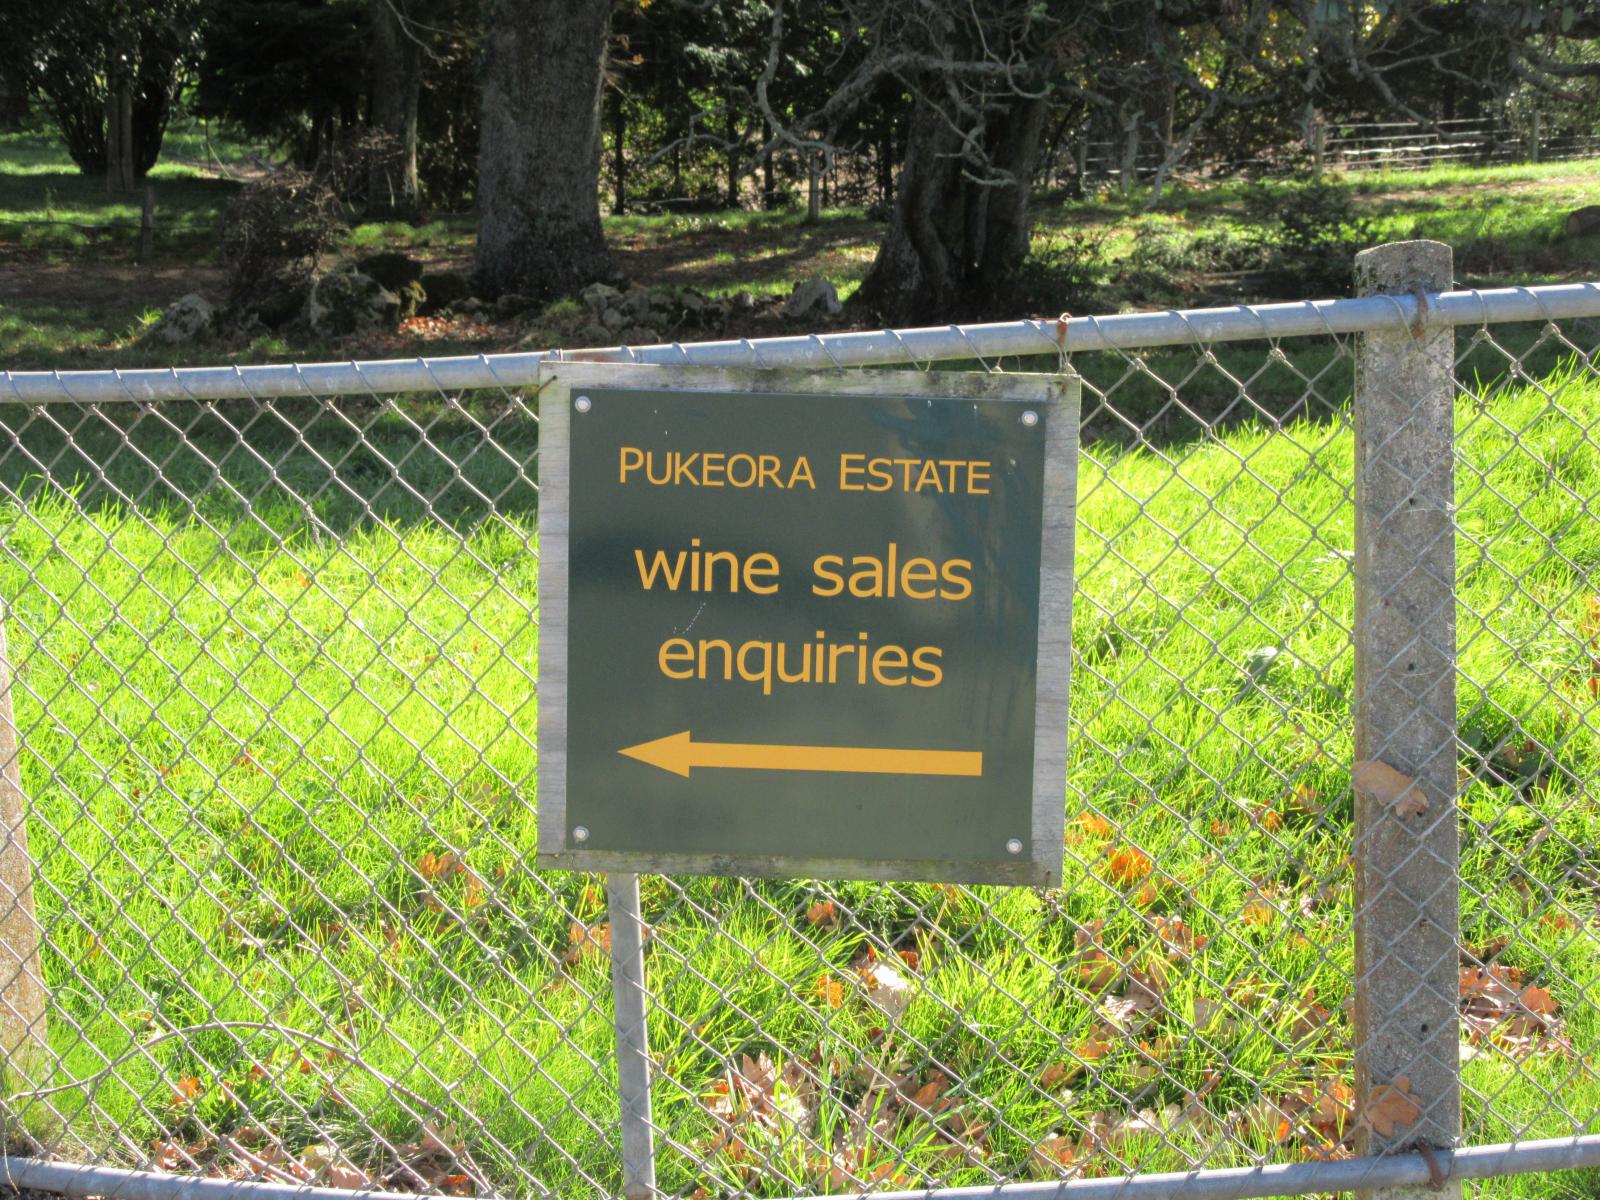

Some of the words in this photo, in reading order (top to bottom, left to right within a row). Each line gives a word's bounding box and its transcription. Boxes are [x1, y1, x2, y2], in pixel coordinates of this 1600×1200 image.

[618, 446, 817, 490] PUKEORA
[838, 452, 993, 496] ESTATE
[634, 537, 781, 596] wine
[811, 542, 974, 601] sales
[657, 629, 944, 697] enquiries
